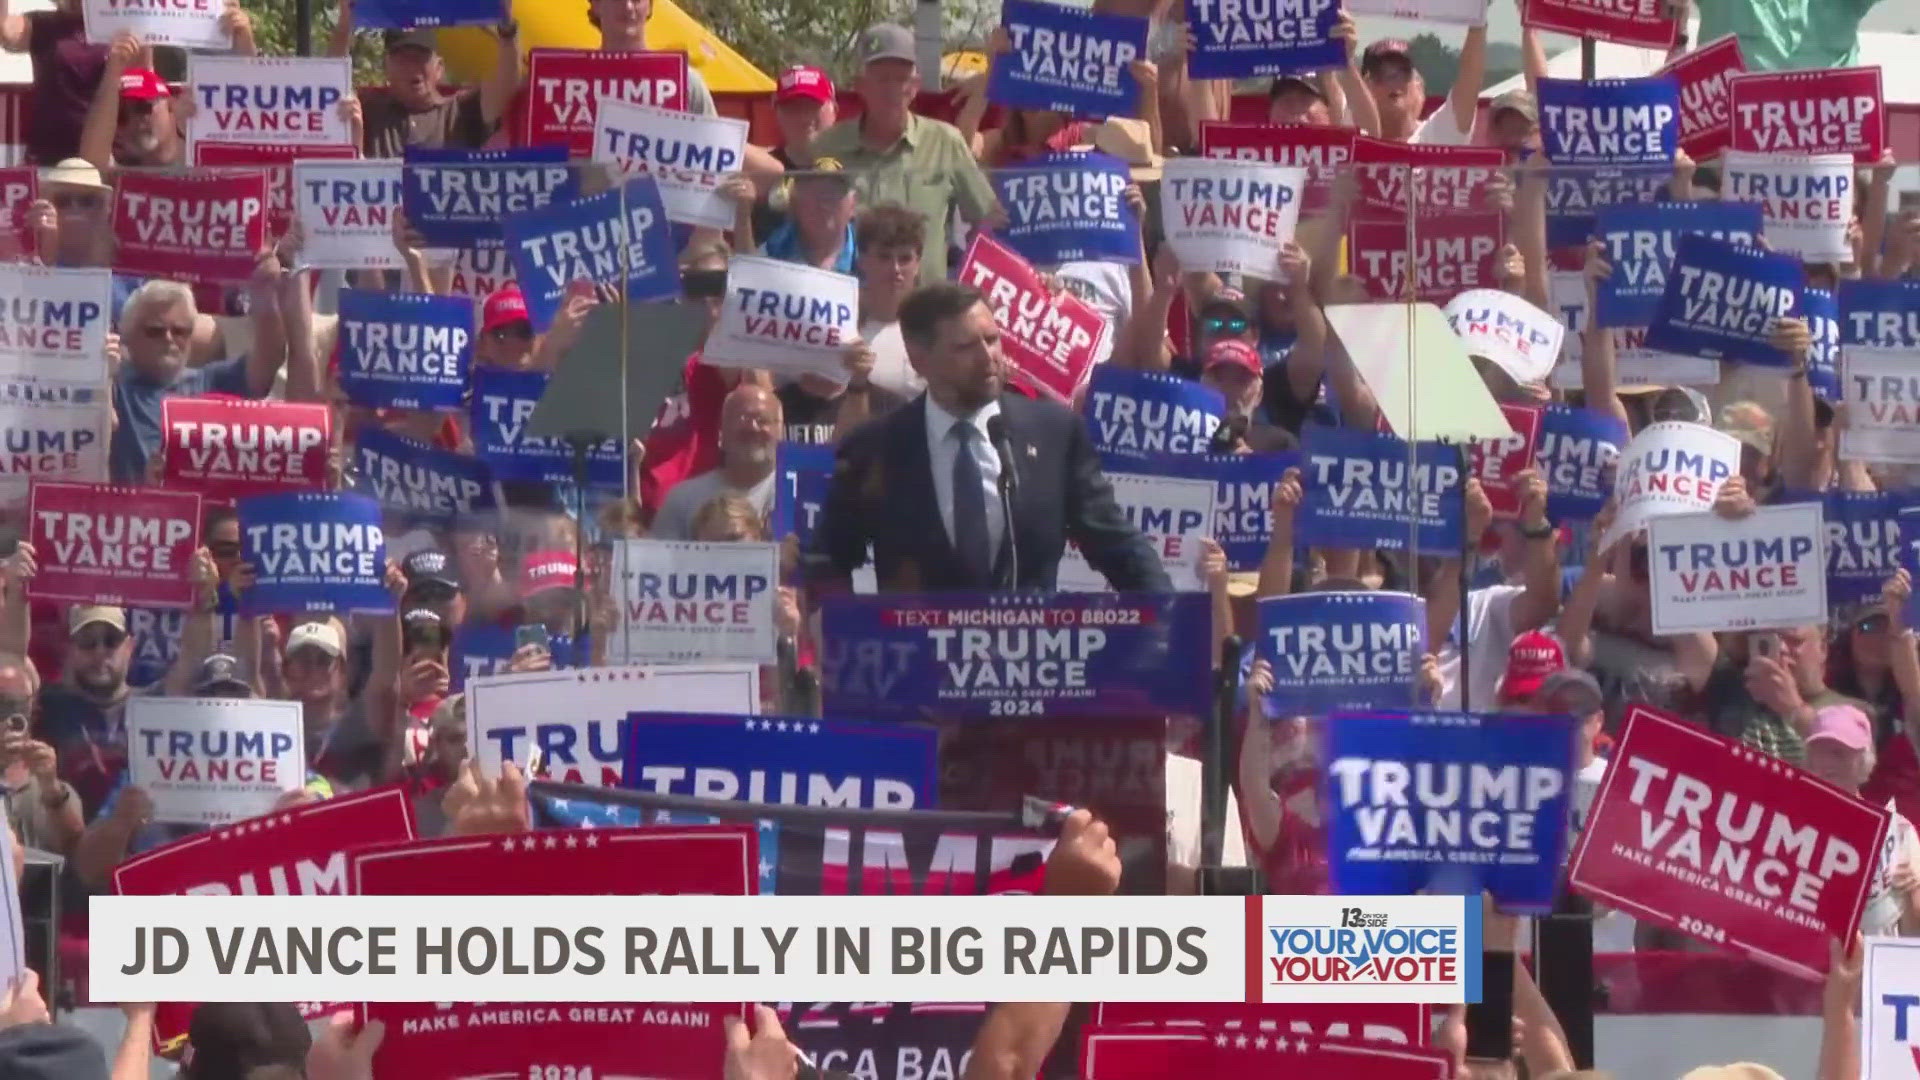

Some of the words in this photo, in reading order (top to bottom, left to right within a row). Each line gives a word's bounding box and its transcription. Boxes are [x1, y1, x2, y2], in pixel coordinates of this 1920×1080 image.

[1193, 0, 1332, 23] TRUMP
[1010, 22, 1137, 68] TRUMP
[1210, 18, 1317, 44] VANCE
[1019, 48, 1120, 88] VANCE
[198, 85, 341, 111] TRUMP
[538, 78, 677, 107] TRUMP
[214, 110, 325, 132] VANCE
[1545, 104, 1673, 133] TRUMP
[1738, 96, 1875, 131] TRUMP
[604, 127, 736, 173] TRUMP
[1557, 131, 1662, 155] VANCE
[1752, 123, 1862, 150] VANCE
[413, 167, 569, 195] TRUMP
[1003, 172, 1127, 203] TRUMP
[1170, 177, 1293, 210] TRUMP
[1730, 172, 1849, 198] TRUMP
[122, 191, 260, 227] TRUMP
[321, 205, 386, 227] VAN
[1017, 195, 1119, 224] VANCE
[1182, 202, 1279, 237] VANCE
[134, 218, 247, 249] VANCE
[521, 206, 655, 268] TRUMP
[1361, 236, 1495, 278] TRUMP
[737, 287, 851, 328] TRUMP
[970, 261, 1090, 350] TRUMP
[1680, 265, 1794, 318] TRUMP
[744, 315, 841, 348] VANCE
[1464, 308, 1550, 347] UMP
[1685, 298, 1781, 337] VANCE
[0, 328, 83, 350] ANCE
[345, 321, 468, 355] TRUMP
[993, 305, 1071, 365] ANCE
[355, 349, 458, 377] VANCE
[1093, 392, 1221, 439] TRUMP
[6, 428, 94, 454] UMP
[173, 422, 323, 452] TRUMP
[1099, 420, 1211, 454] VANCE
[1536, 433, 1621, 468] UMP
[189, 448, 303, 476] VANCE
[361, 448, 481, 498] TRUMP
[1311, 456, 1458, 494] TRUMP
[1327, 485, 1440, 518] VANCE
[1628, 472, 1713, 502] ANCE
[38, 511, 192, 547] TRUMP
[1214, 510, 1275, 533] NCE
[248, 523, 384, 554] TRUMP
[1660, 536, 1813, 573] TRUMP
[53, 543, 172, 571] VANCE
[259, 552, 375, 576] VANCE
[1679, 565, 1799, 594] VANCE
[628, 600, 749, 625] VANCE
[894, 610, 942, 626] TEXT
[948, 609, 1044, 626] MICHIGAN
[1051, 610, 1076, 625] TO
[1081, 609, 1141, 625] 88022
[927, 628, 1107, 662] TRUMP
[1269, 623, 1421, 656] TRUMP
[948, 661, 1086, 688] VANCE
[1286, 652, 1413, 679] VANCE
[989, 700, 1045, 716] 2024
[140, 729, 293, 757] TRUMP
[486, 719, 626, 769] TRU
[158, 759, 278, 782] VANCE
[1329, 756, 1563, 811] TRUMP
[642, 766, 915, 810] TRUMP
[1356, 806, 1535, 850] VANCE
[1627, 756, 1860, 881] TRUMP
[1639, 811, 1826, 914] VANCE
[1612, 842, 1653, 868] MAKE
[1655, 858, 1720, 893] AMERICA
[1723, 885, 1771, 914] GREAT
[1774, 902, 1827, 932] AGAIN!
[1678, 915, 1726, 944] 2024
[402, 1012, 459, 1034] MAKE
[466, 1009, 562, 1028] AMERICA
[568, 1007, 635, 1024] GREAT
[642, 1009, 710, 1028] AGAIN!
